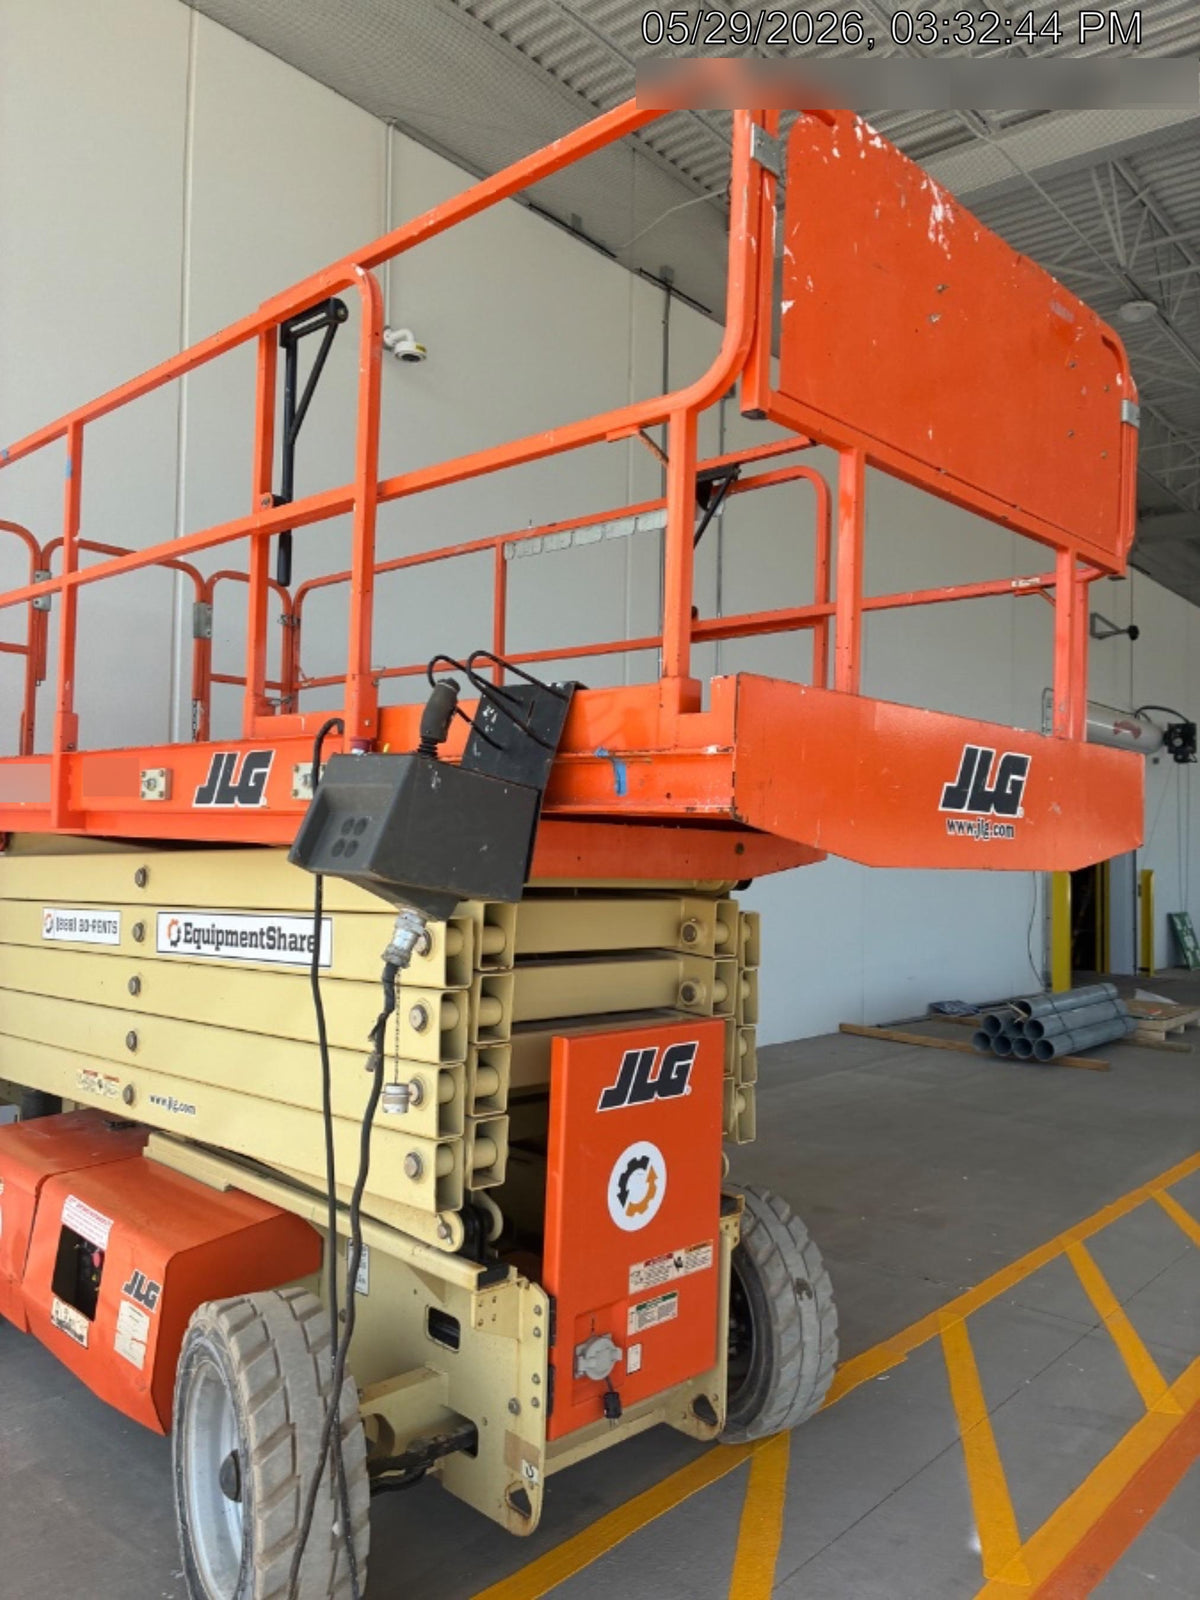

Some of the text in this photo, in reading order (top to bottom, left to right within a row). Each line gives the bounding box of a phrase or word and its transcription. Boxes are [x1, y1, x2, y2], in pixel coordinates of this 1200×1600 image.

[192, 750, 275, 807] JLG
[939, 744, 1031, 818] JLG
[947, 817, 1015, 841] www.jlg.com
[183, 921, 317, 953] EquipmentShare
[597, 1040, 699, 1112] JLG
[121, 1269, 162, 1313] JLG
